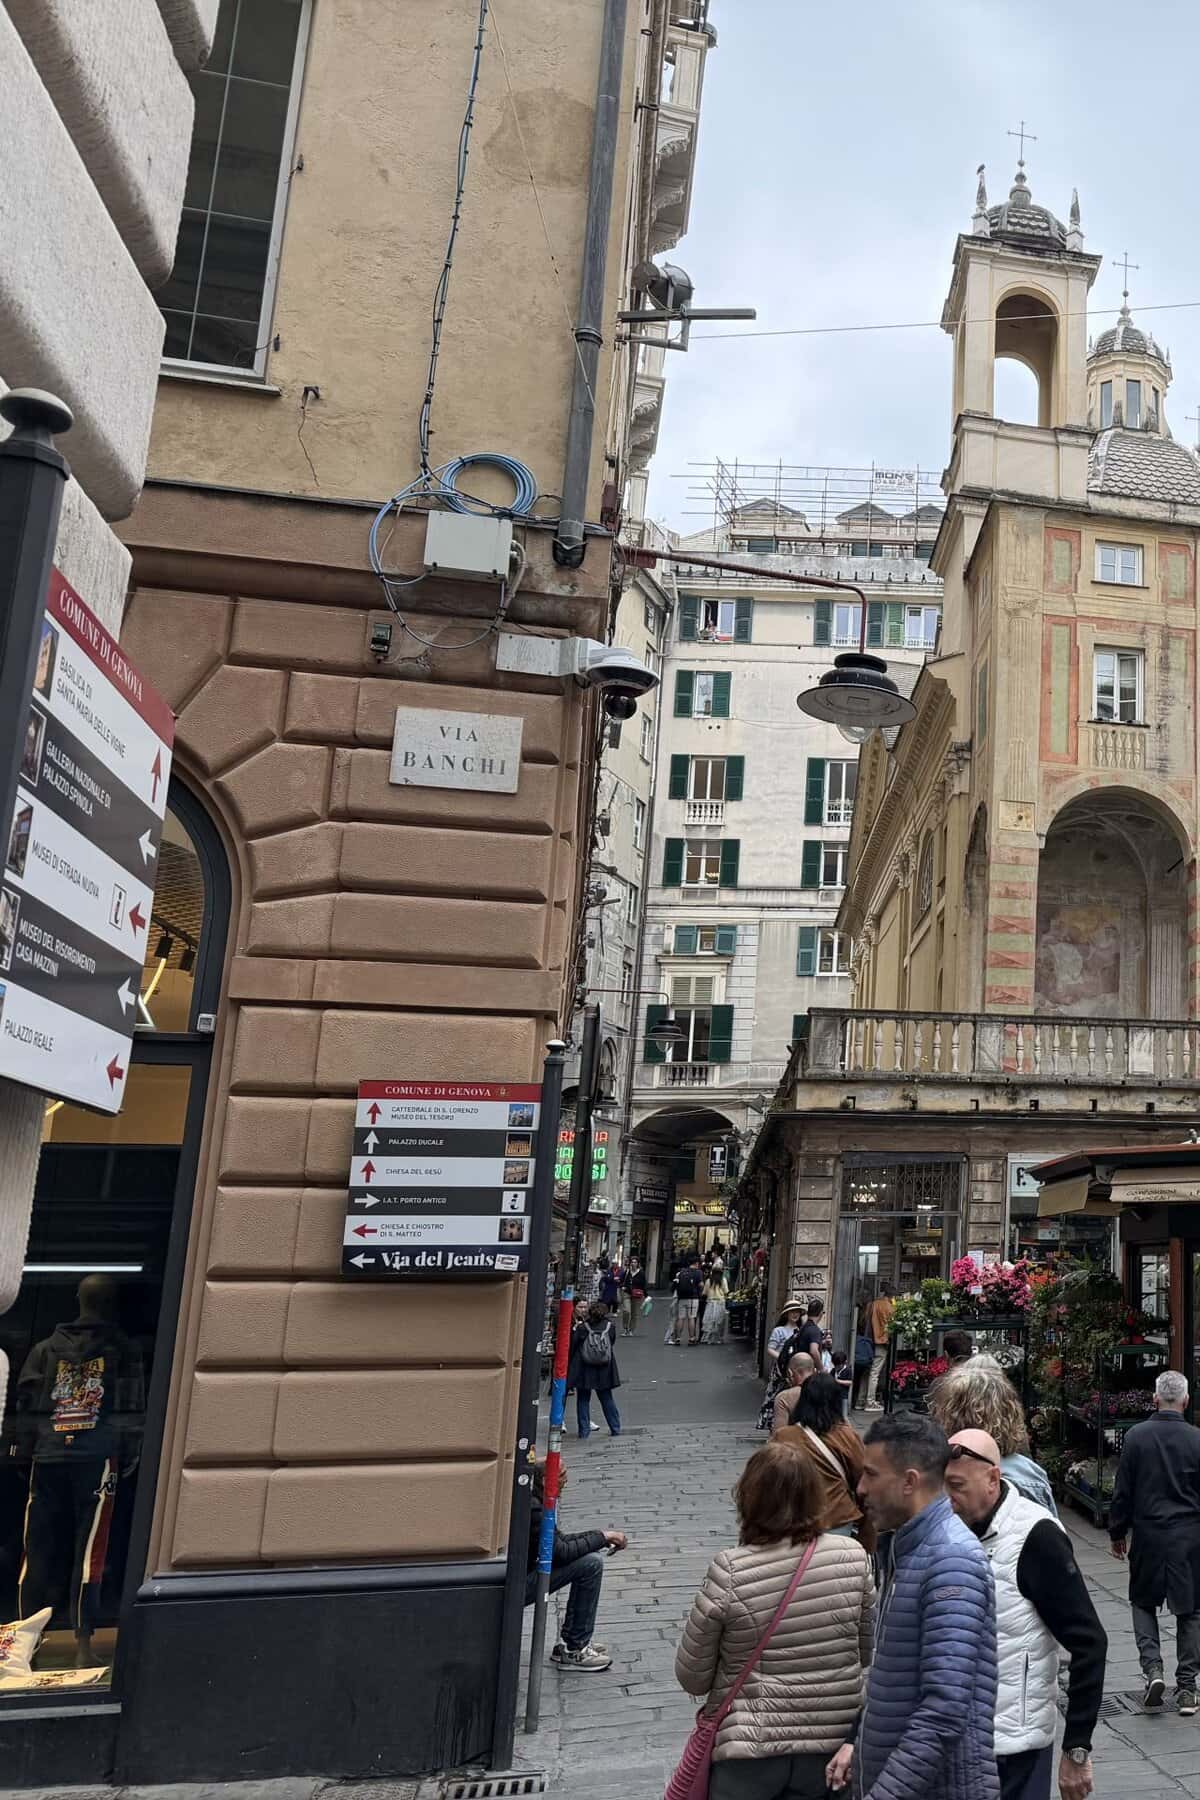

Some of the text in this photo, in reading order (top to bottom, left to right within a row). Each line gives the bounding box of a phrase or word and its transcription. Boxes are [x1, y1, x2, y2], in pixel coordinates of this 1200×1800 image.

[60, 589, 144, 701] COMUNE DI GENOVA
[60, 656, 93, 700] BASILICA DI
[56, 678, 127, 759] SANTA MARIA DELLE VIGNE
[439, 725, 478, 743] VIA
[46, 740, 75, 779] GALLERIA
[75, 766, 106, 806] NAZIONALE
[402, 751, 507, 776] BANCHI
[43, 763, 94, 817] PALAZZO SPINOLA
[32, 839, 52, 867] MUSEI
[59, 859, 82, 888] STRADA
[81, 875, 100, 900] NUOVA
[15, 942, 60, 977] CASA MAZZINI
[19, 917, 97, 975] MUSEO DEL RISORGIMENTO
[5, 1019, 54, 1052] PALAZZO REALE
[385, 1086, 491, 1097] COMUNE DI GENOVA
[381, 1251, 411, 1267] Via
[414, 1250, 443, 1267] del
[445, 1251, 495, 1270] Jeans
